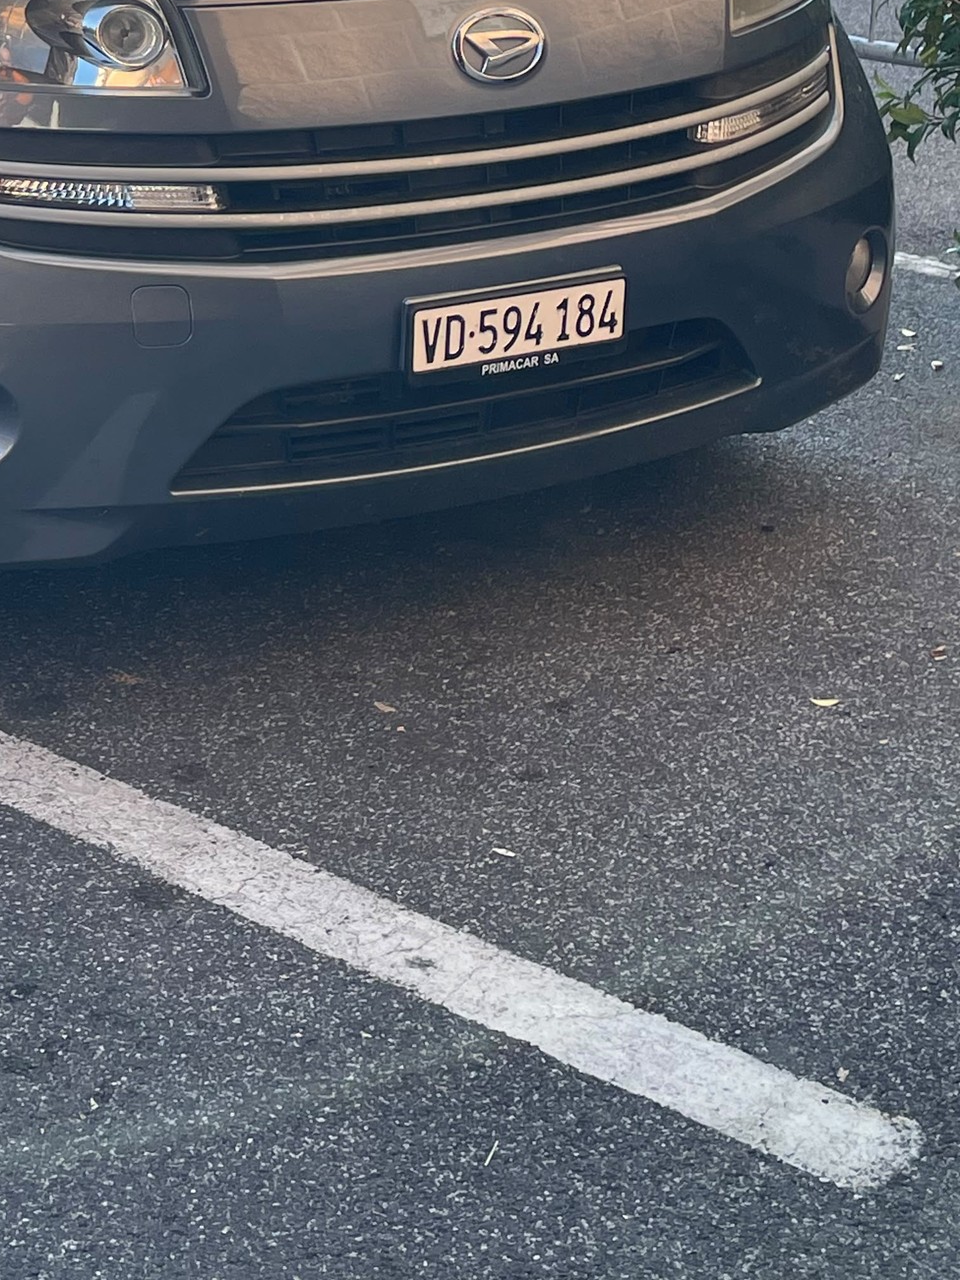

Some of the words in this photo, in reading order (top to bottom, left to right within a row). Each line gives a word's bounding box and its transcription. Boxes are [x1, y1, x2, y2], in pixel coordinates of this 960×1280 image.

[556, 289, 618, 342] 184
[481, 355, 539, 376] PRIMACAR
[543, 352, 559, 364] SA
